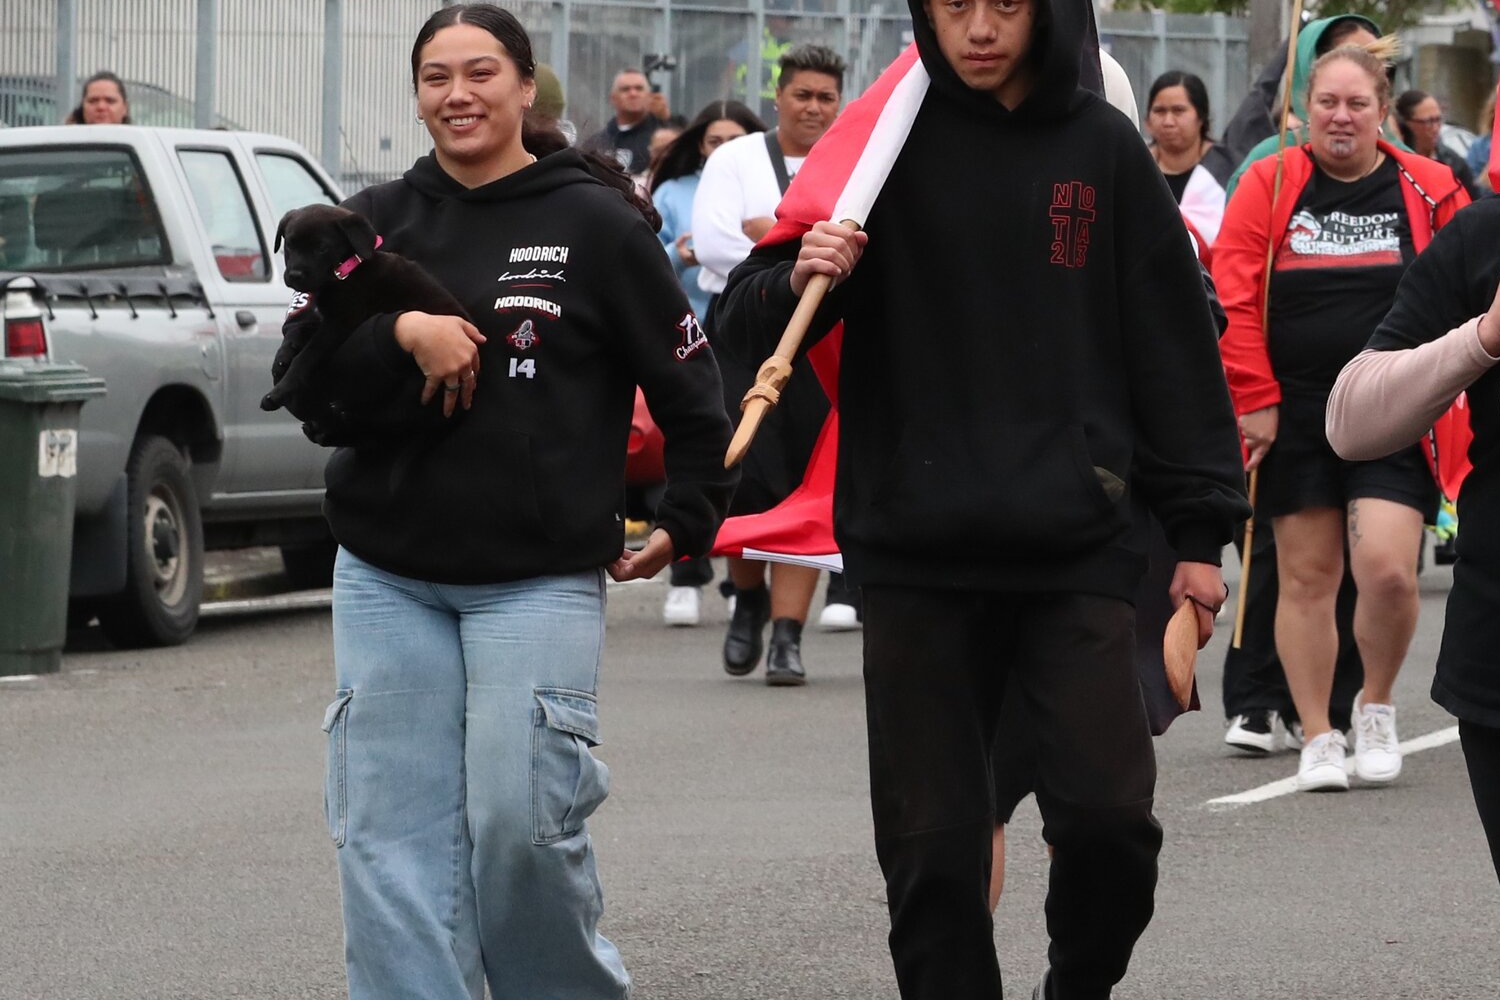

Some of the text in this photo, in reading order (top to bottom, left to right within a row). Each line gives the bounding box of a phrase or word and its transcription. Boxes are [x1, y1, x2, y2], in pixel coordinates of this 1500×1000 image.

[1323, 211, 1399, 227] FREEDOM
[1322, 228, 1396, 244] FUTURE
[1334, 223, 1346, 234] IS
[509, 246, 569, 264] HOODRICH
[494, 296, 562, 317] HOODRICH
[508, 357, 536, 379] 14
